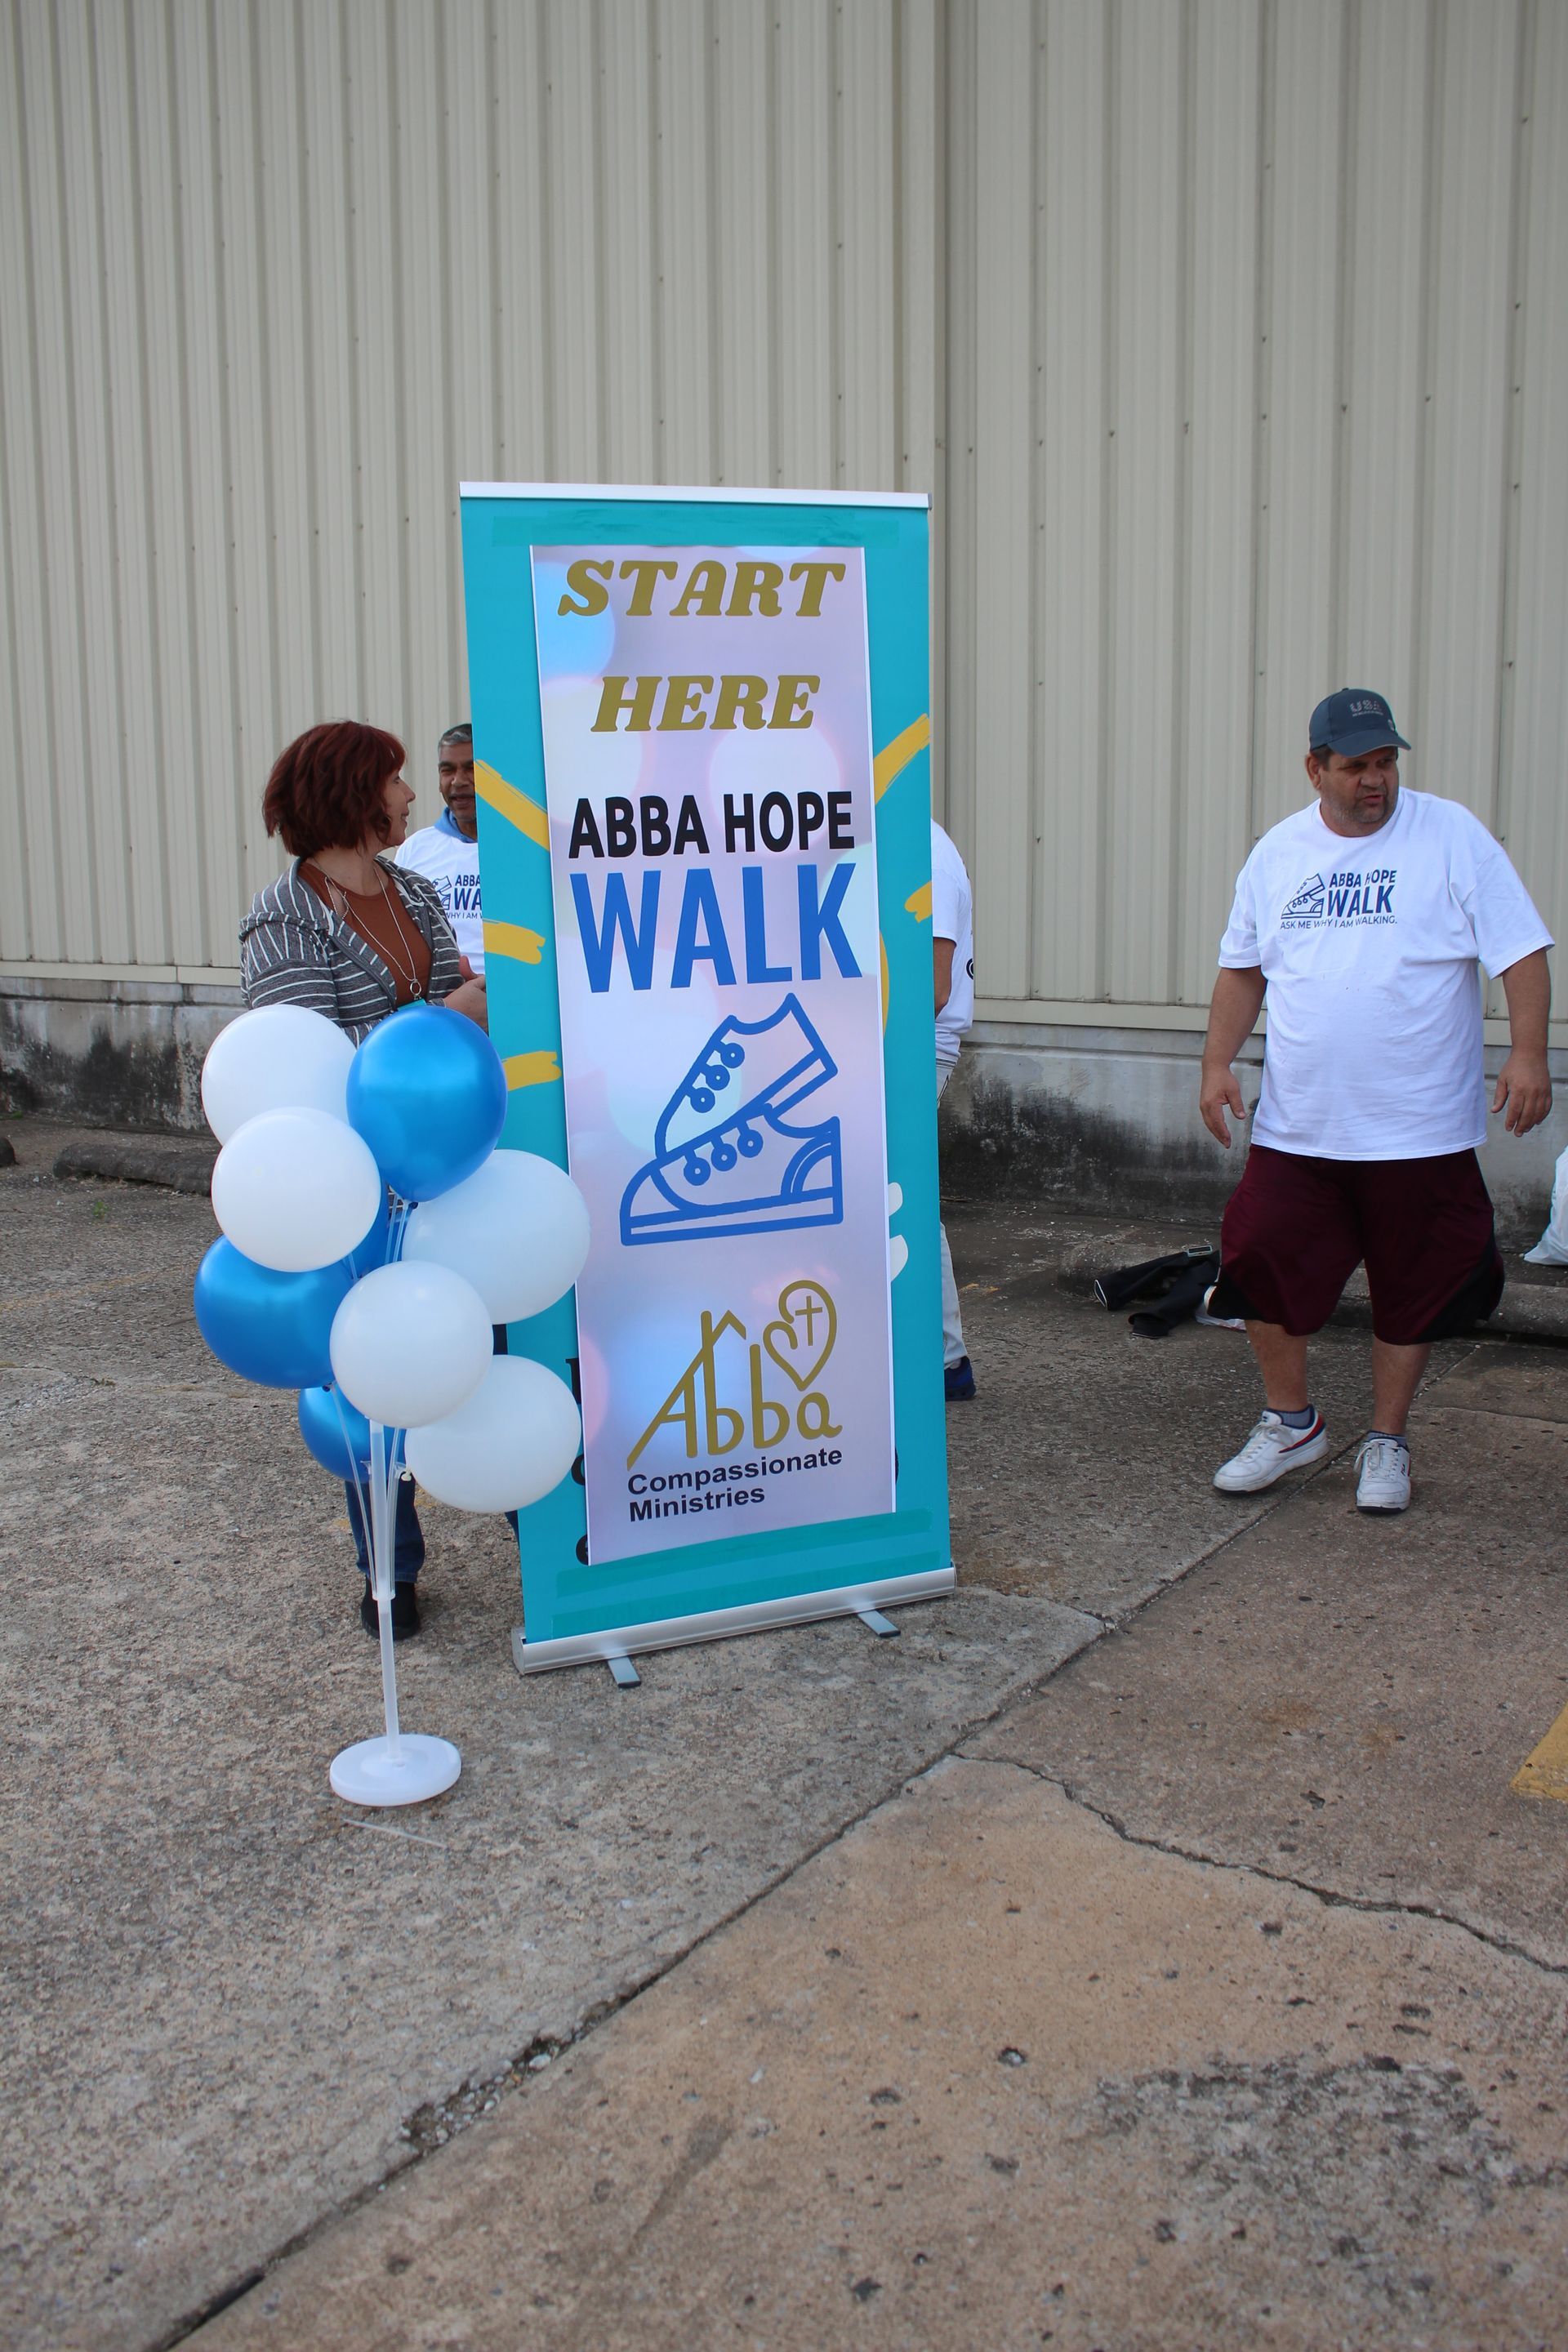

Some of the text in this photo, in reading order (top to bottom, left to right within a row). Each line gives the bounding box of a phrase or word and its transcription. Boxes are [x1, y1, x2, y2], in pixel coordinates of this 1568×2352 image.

[557, 559, 846, 617] START
[590, 675, 822, 733] HERE
[568, 791, 856, 859] ABBA HOPE
[1327, 885, 1395, 918] WALK
[1330, 869, 1397, 888] ABBA HOPE
[568, 862, 863, 994] WALK
[1280, 915, 1397, 929] ASK ME WHY I AM WALKING.
[627, 1310, 843, 1471] Abba
[627, 1448, 843, 1495] Compassionate
[629, 1486, 765, 1522] Ministries
